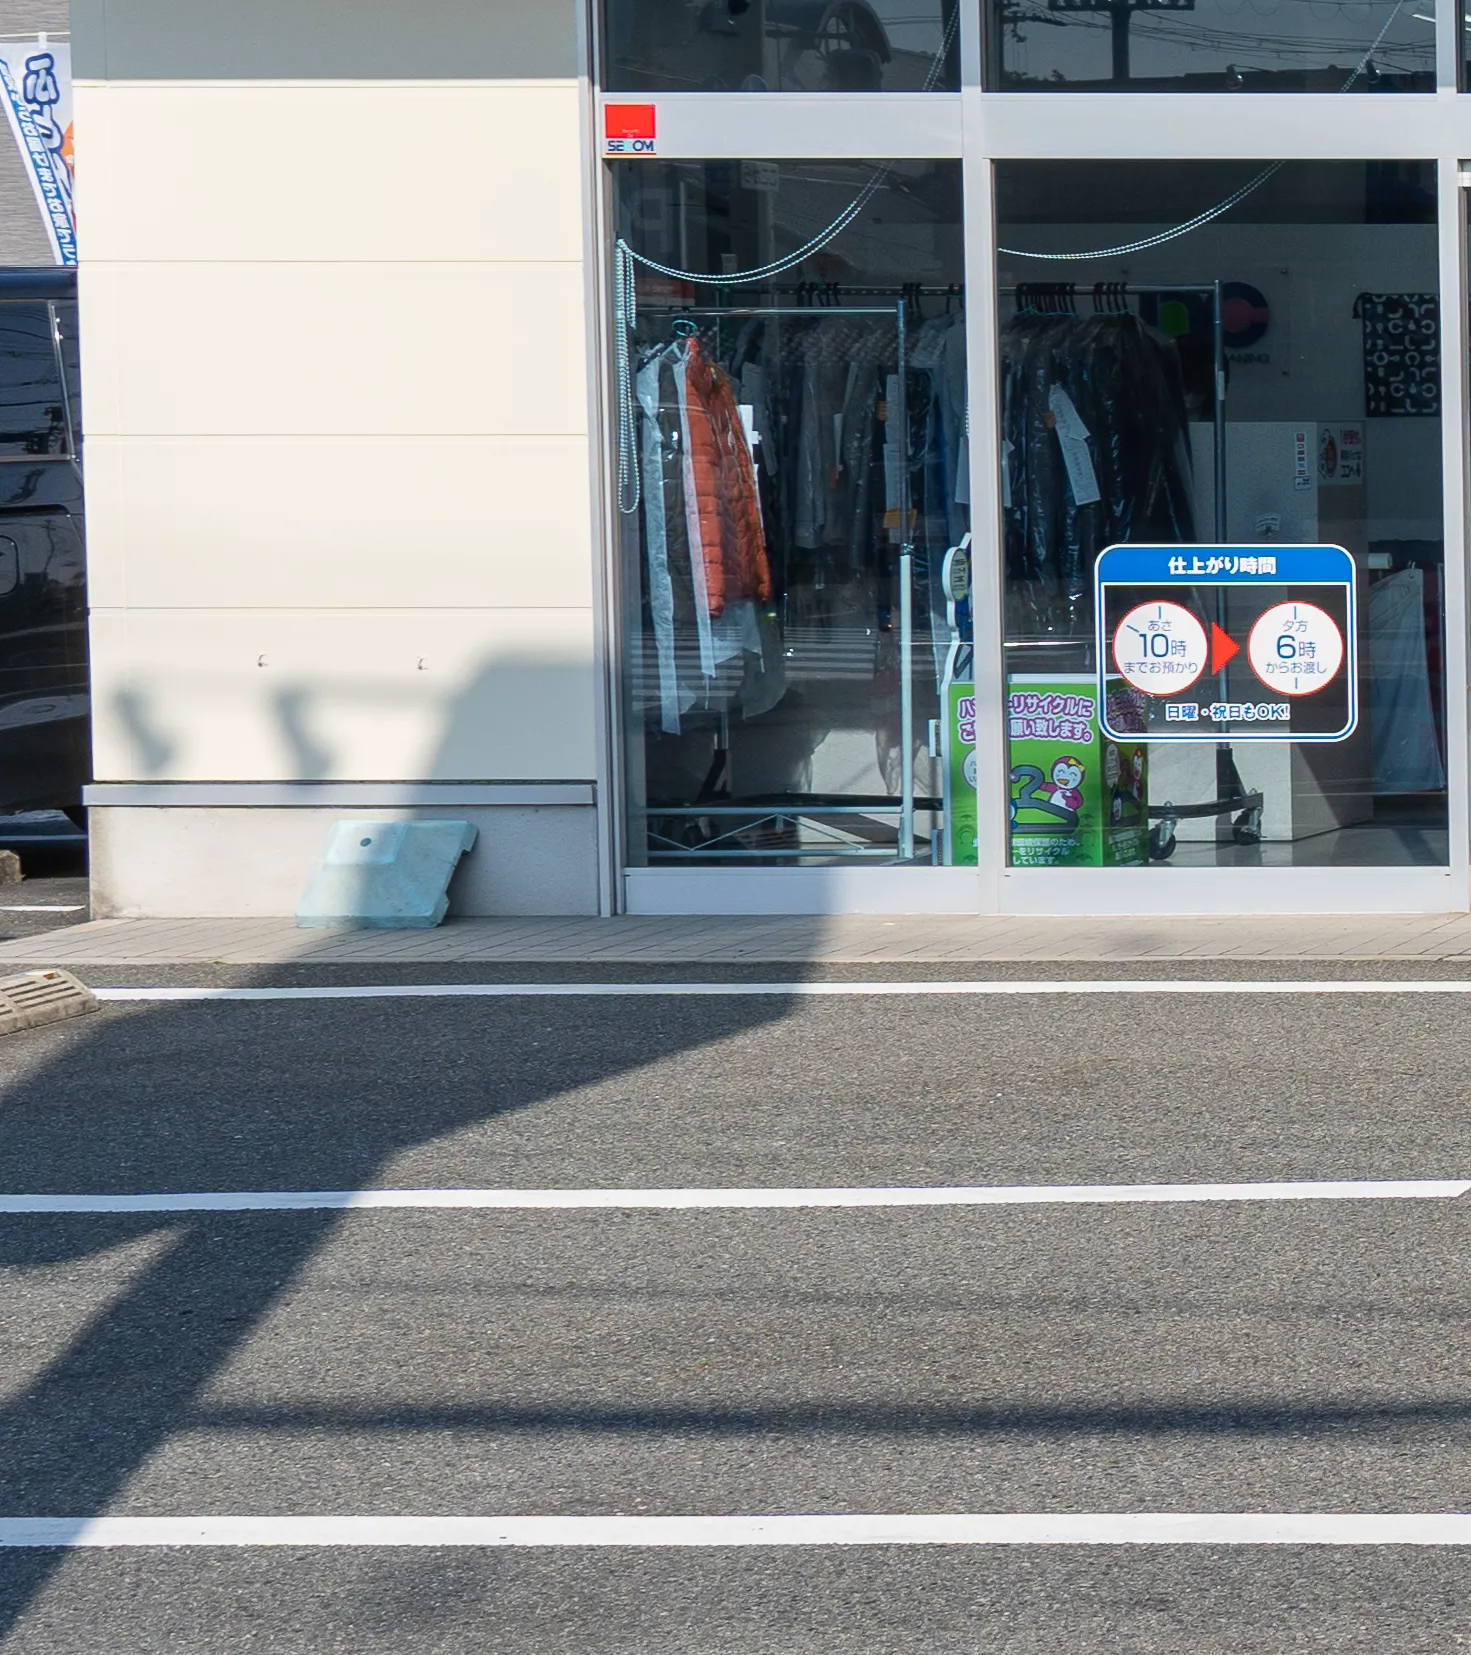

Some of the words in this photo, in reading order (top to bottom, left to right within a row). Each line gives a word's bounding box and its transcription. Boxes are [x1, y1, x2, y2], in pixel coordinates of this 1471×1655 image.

[608, 139, 654, 152] SECOM
[1168, 556, 1277, 575] 仕上がり時間
[1147, 620, 1173, 632] あさ
[1282, 620, 1309, 633] 夕方
[1138, 633, 1187, 658] 10時
[1276, 634, 1316, 659] 6時
[1124, 661, 1198, 675] までお預かり
[1265, 661, 1328, 675] からお渡し
